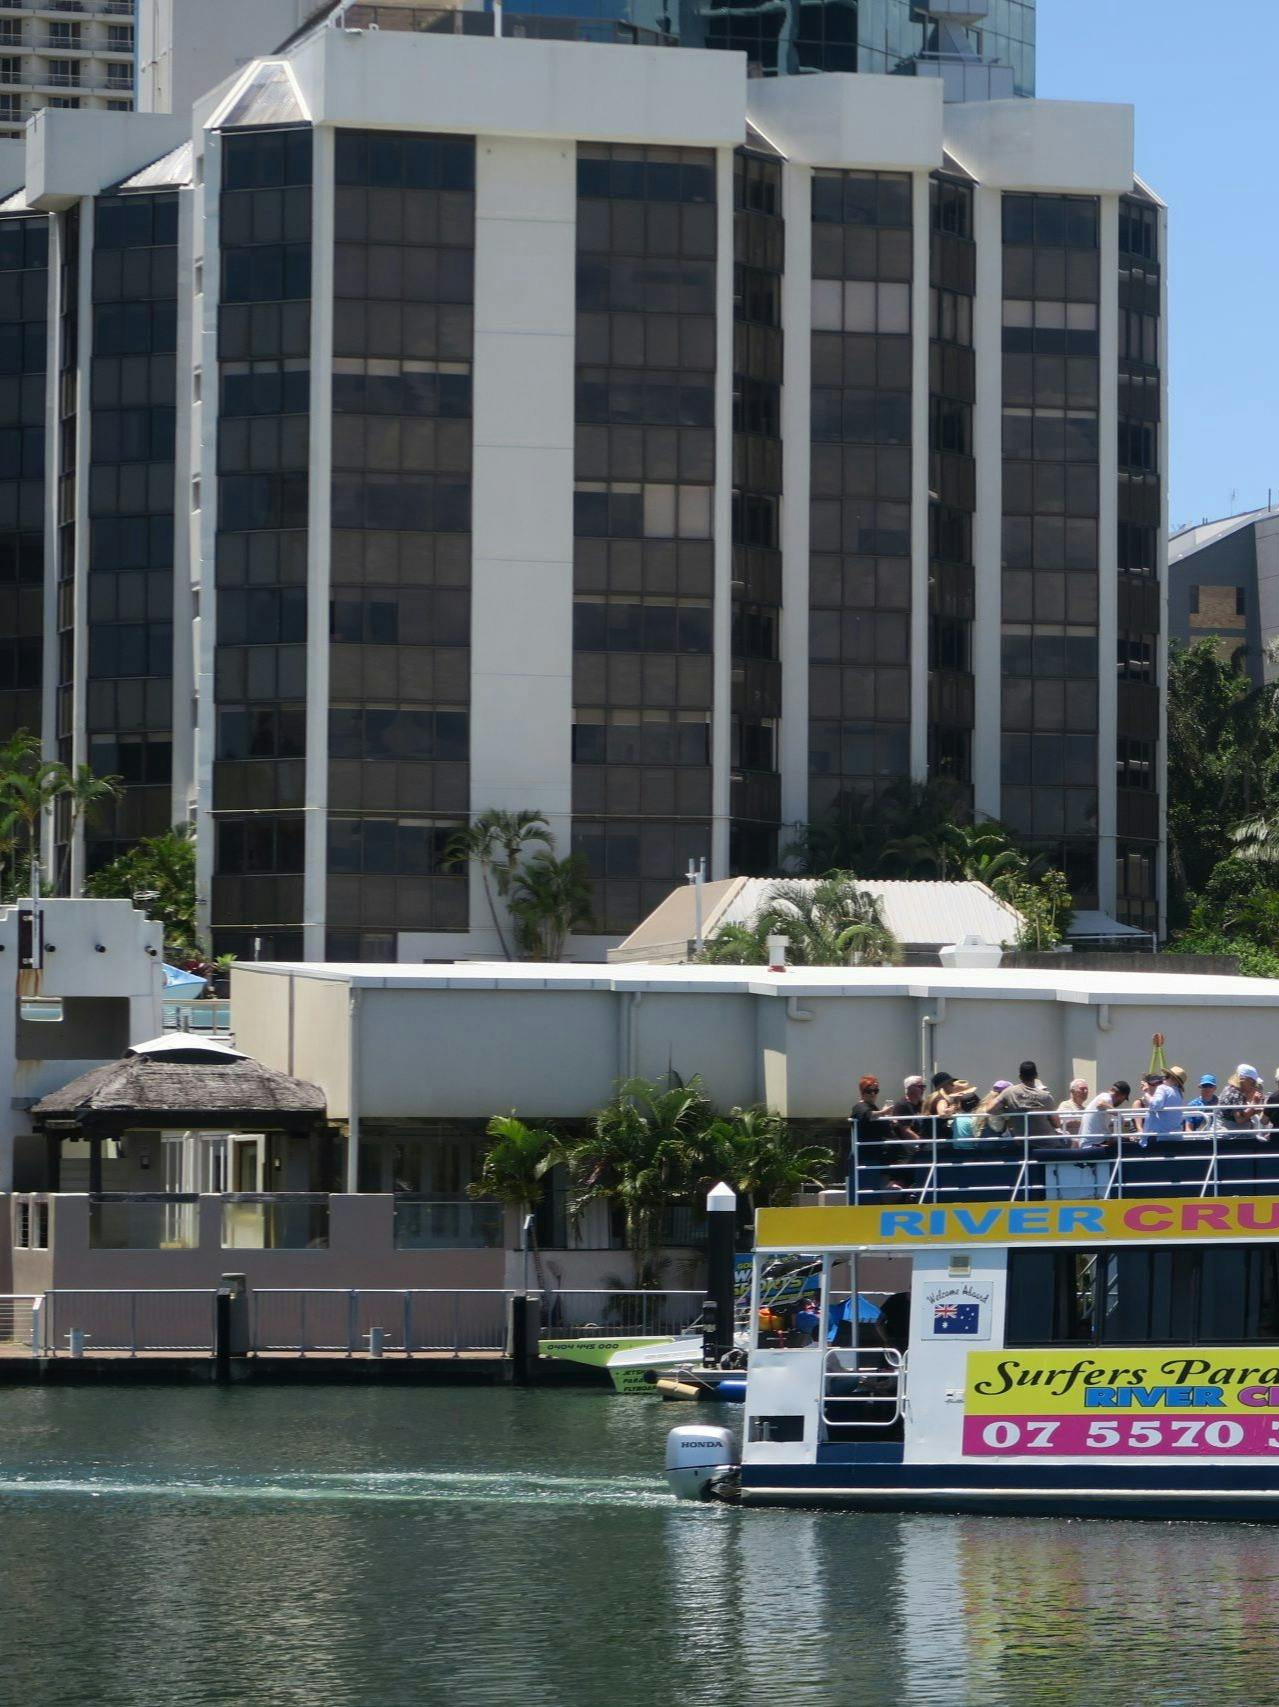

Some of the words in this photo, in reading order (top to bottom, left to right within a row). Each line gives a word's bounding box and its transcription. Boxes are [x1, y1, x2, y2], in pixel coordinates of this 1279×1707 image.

[879, 1206, 1106, 1238] RIVER
[974, 1360, 1147, 1396] Surfers
[1084, 1386, 1227, 1408] RIVER
[982, 1421, 1060, 1449] 07
[1086, 1420, 1244, 1449] 5570
